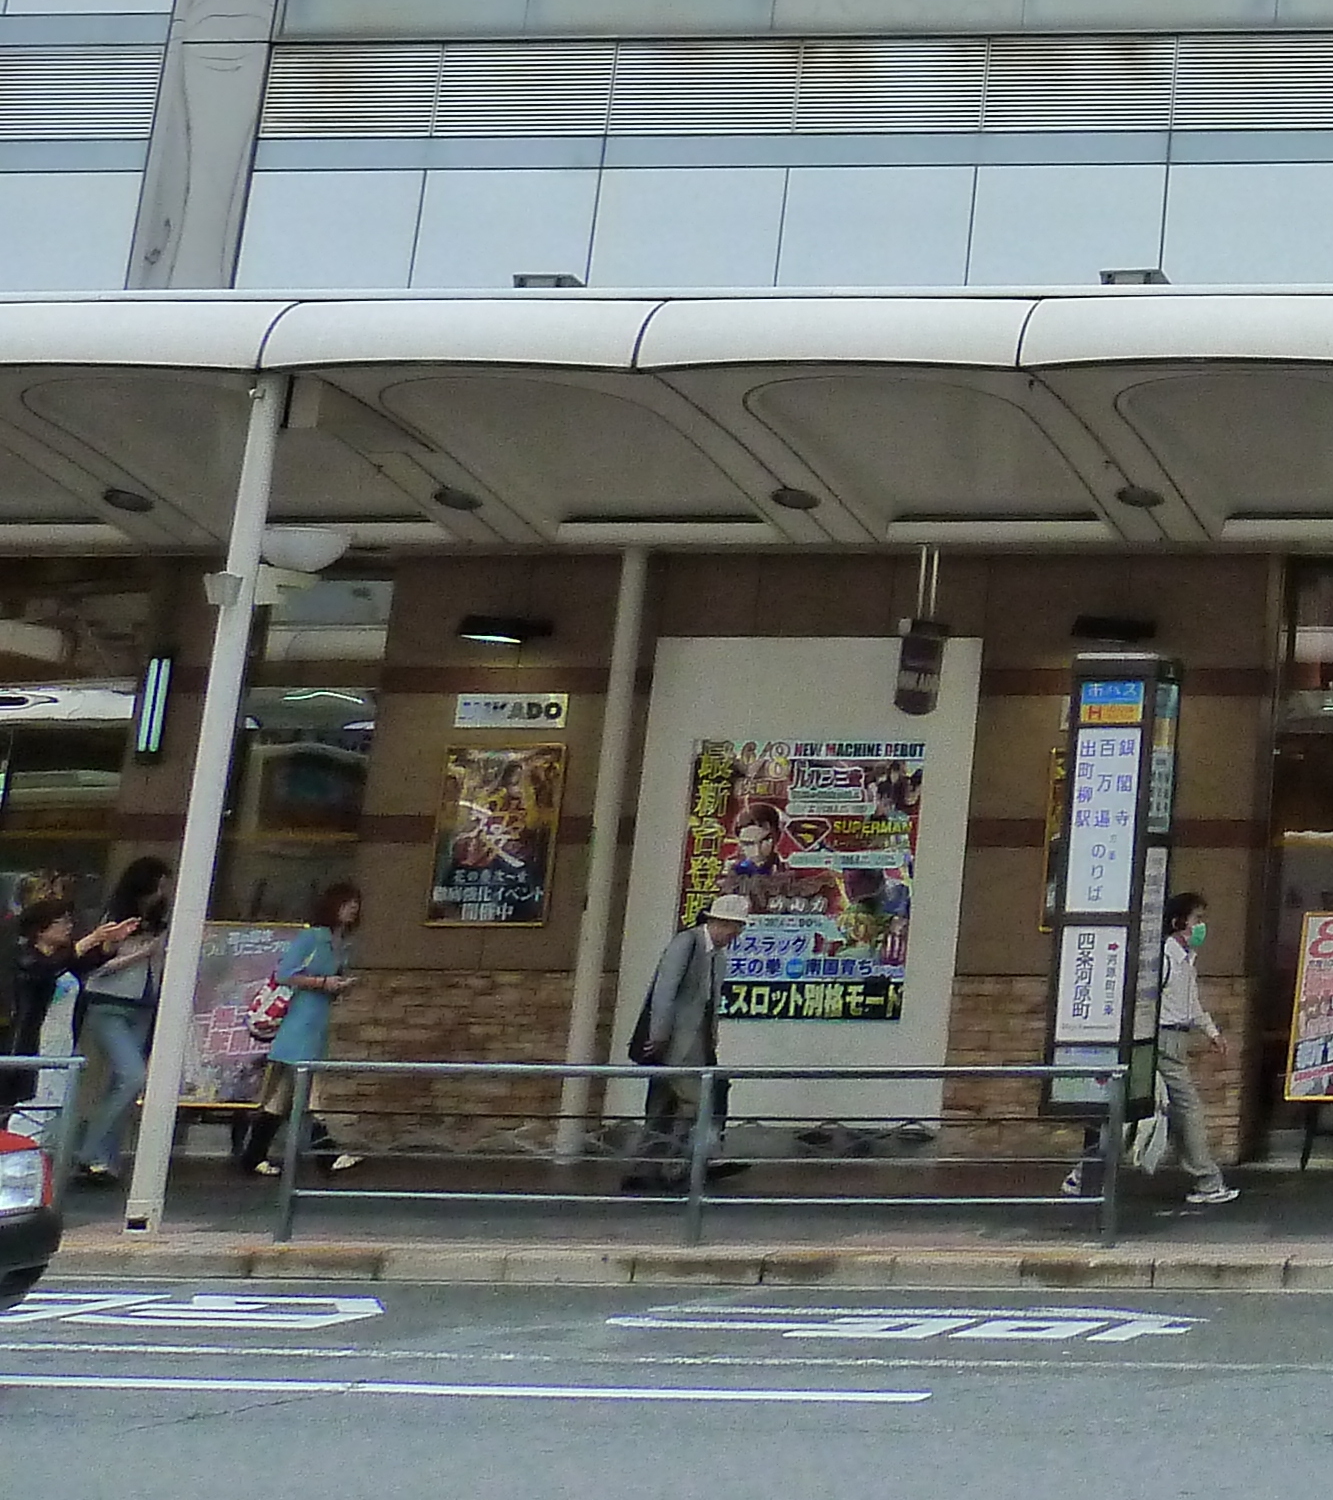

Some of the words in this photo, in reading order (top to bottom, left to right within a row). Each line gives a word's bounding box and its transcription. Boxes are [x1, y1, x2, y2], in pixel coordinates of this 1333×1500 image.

[458, 702, 562, 720] ADO
[794, 743, 823, 757] NEW
[825, 743, 883, 757] MACHINE
[886, 743, 926, 757] DEBUT
[1075, 740, 1096, 828] 出町柳駅
[1093, 739, 1115, 828] 百万遍
[1115, 739, 1135, 827] 銀閣寺
[833, 820, 913, 835] SUPERMAN
[1088, 844, 1106, 902] のりば
[805, 958, 874, 976] 南国育ち
[1072, 933, 1096, 1020] 四条河原町
